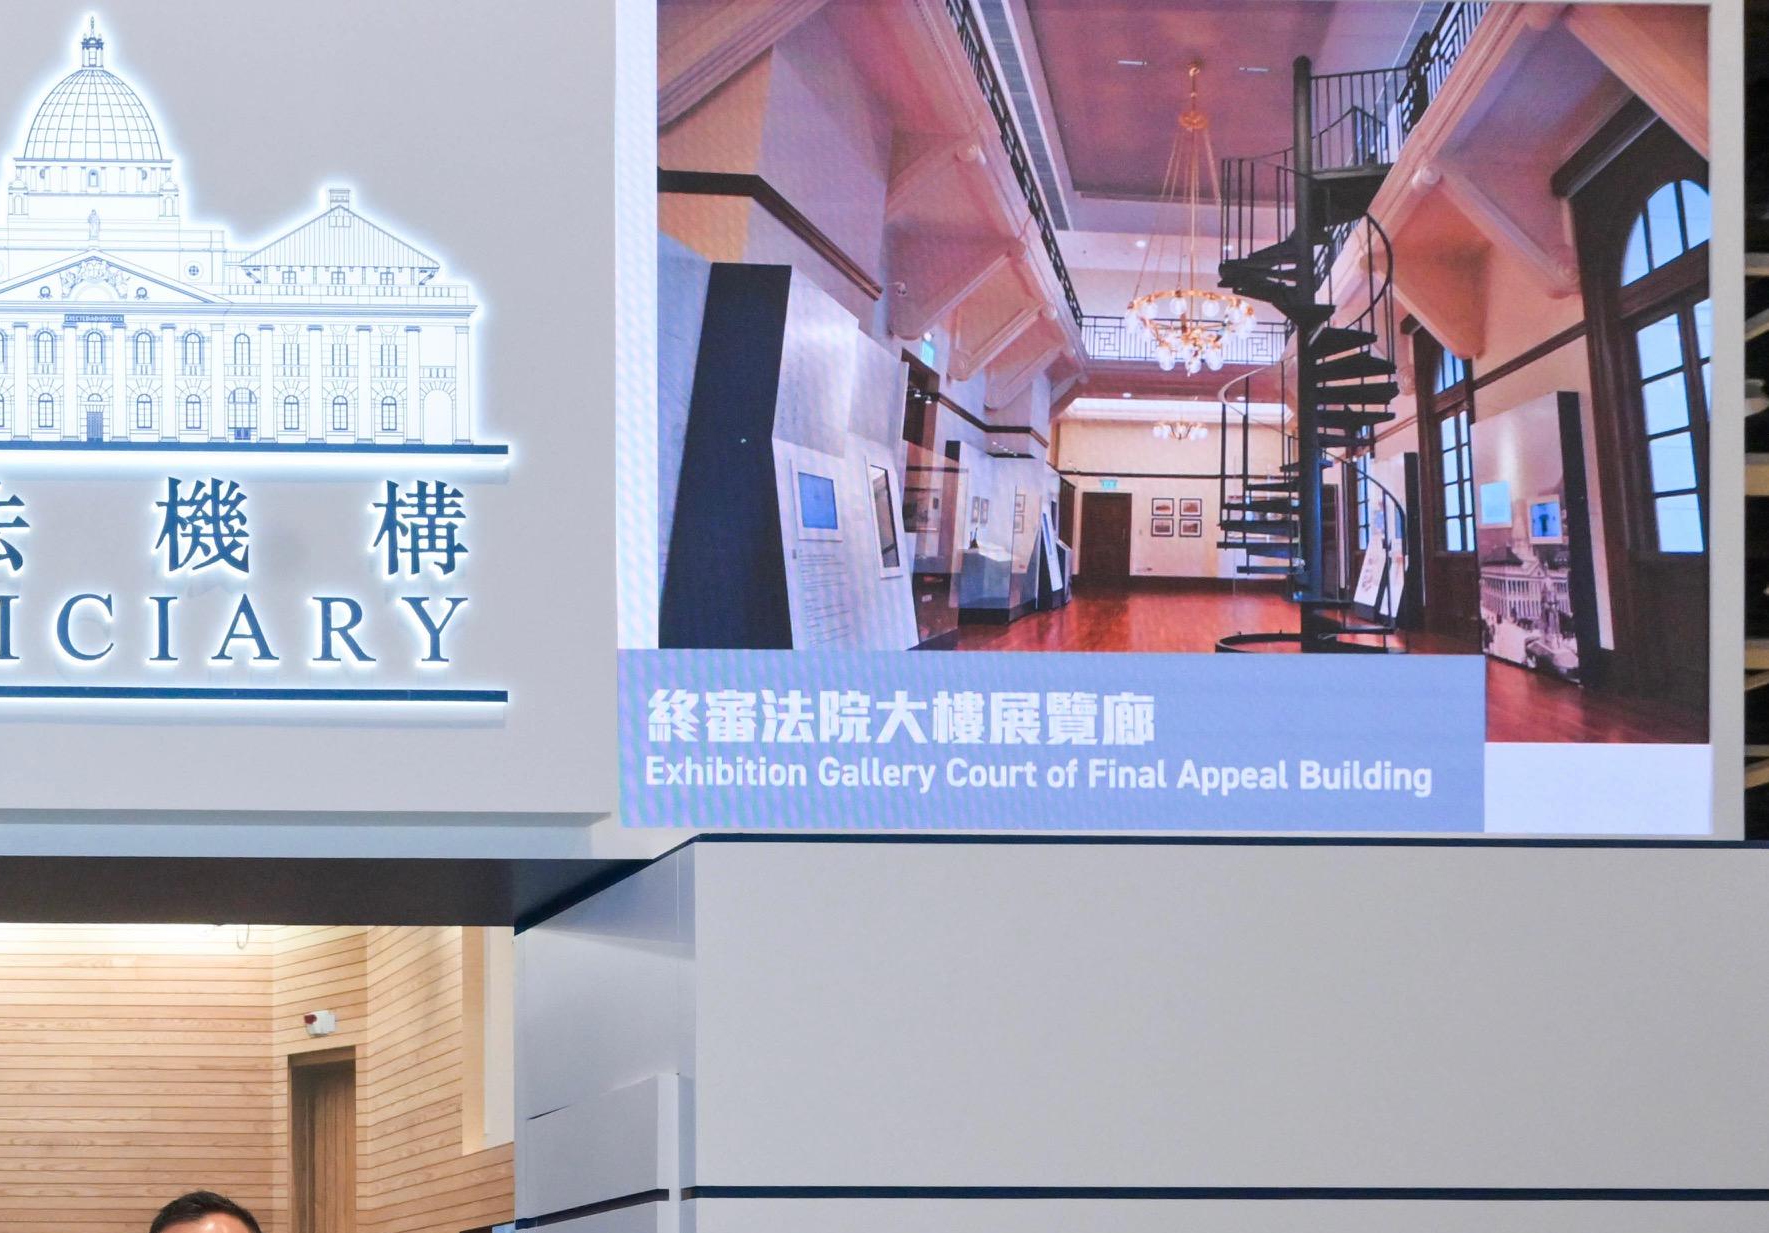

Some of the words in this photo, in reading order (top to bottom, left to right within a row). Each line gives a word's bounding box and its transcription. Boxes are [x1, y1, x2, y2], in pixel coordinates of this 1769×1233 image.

[648, 688, 1156, 746] 終審法院大樓展覽廊
[645, 755, 807, 787] Exhibition
[818, 756, 936, 793] Gallery
[946, 758, 1037, 788] Court
[1046, 758, 1079, 788] of
[1089, 758, 1167, 789] Final
[1177, 760, 1289, 797] Appeal
[1300, 761, 1432, 798] Building
